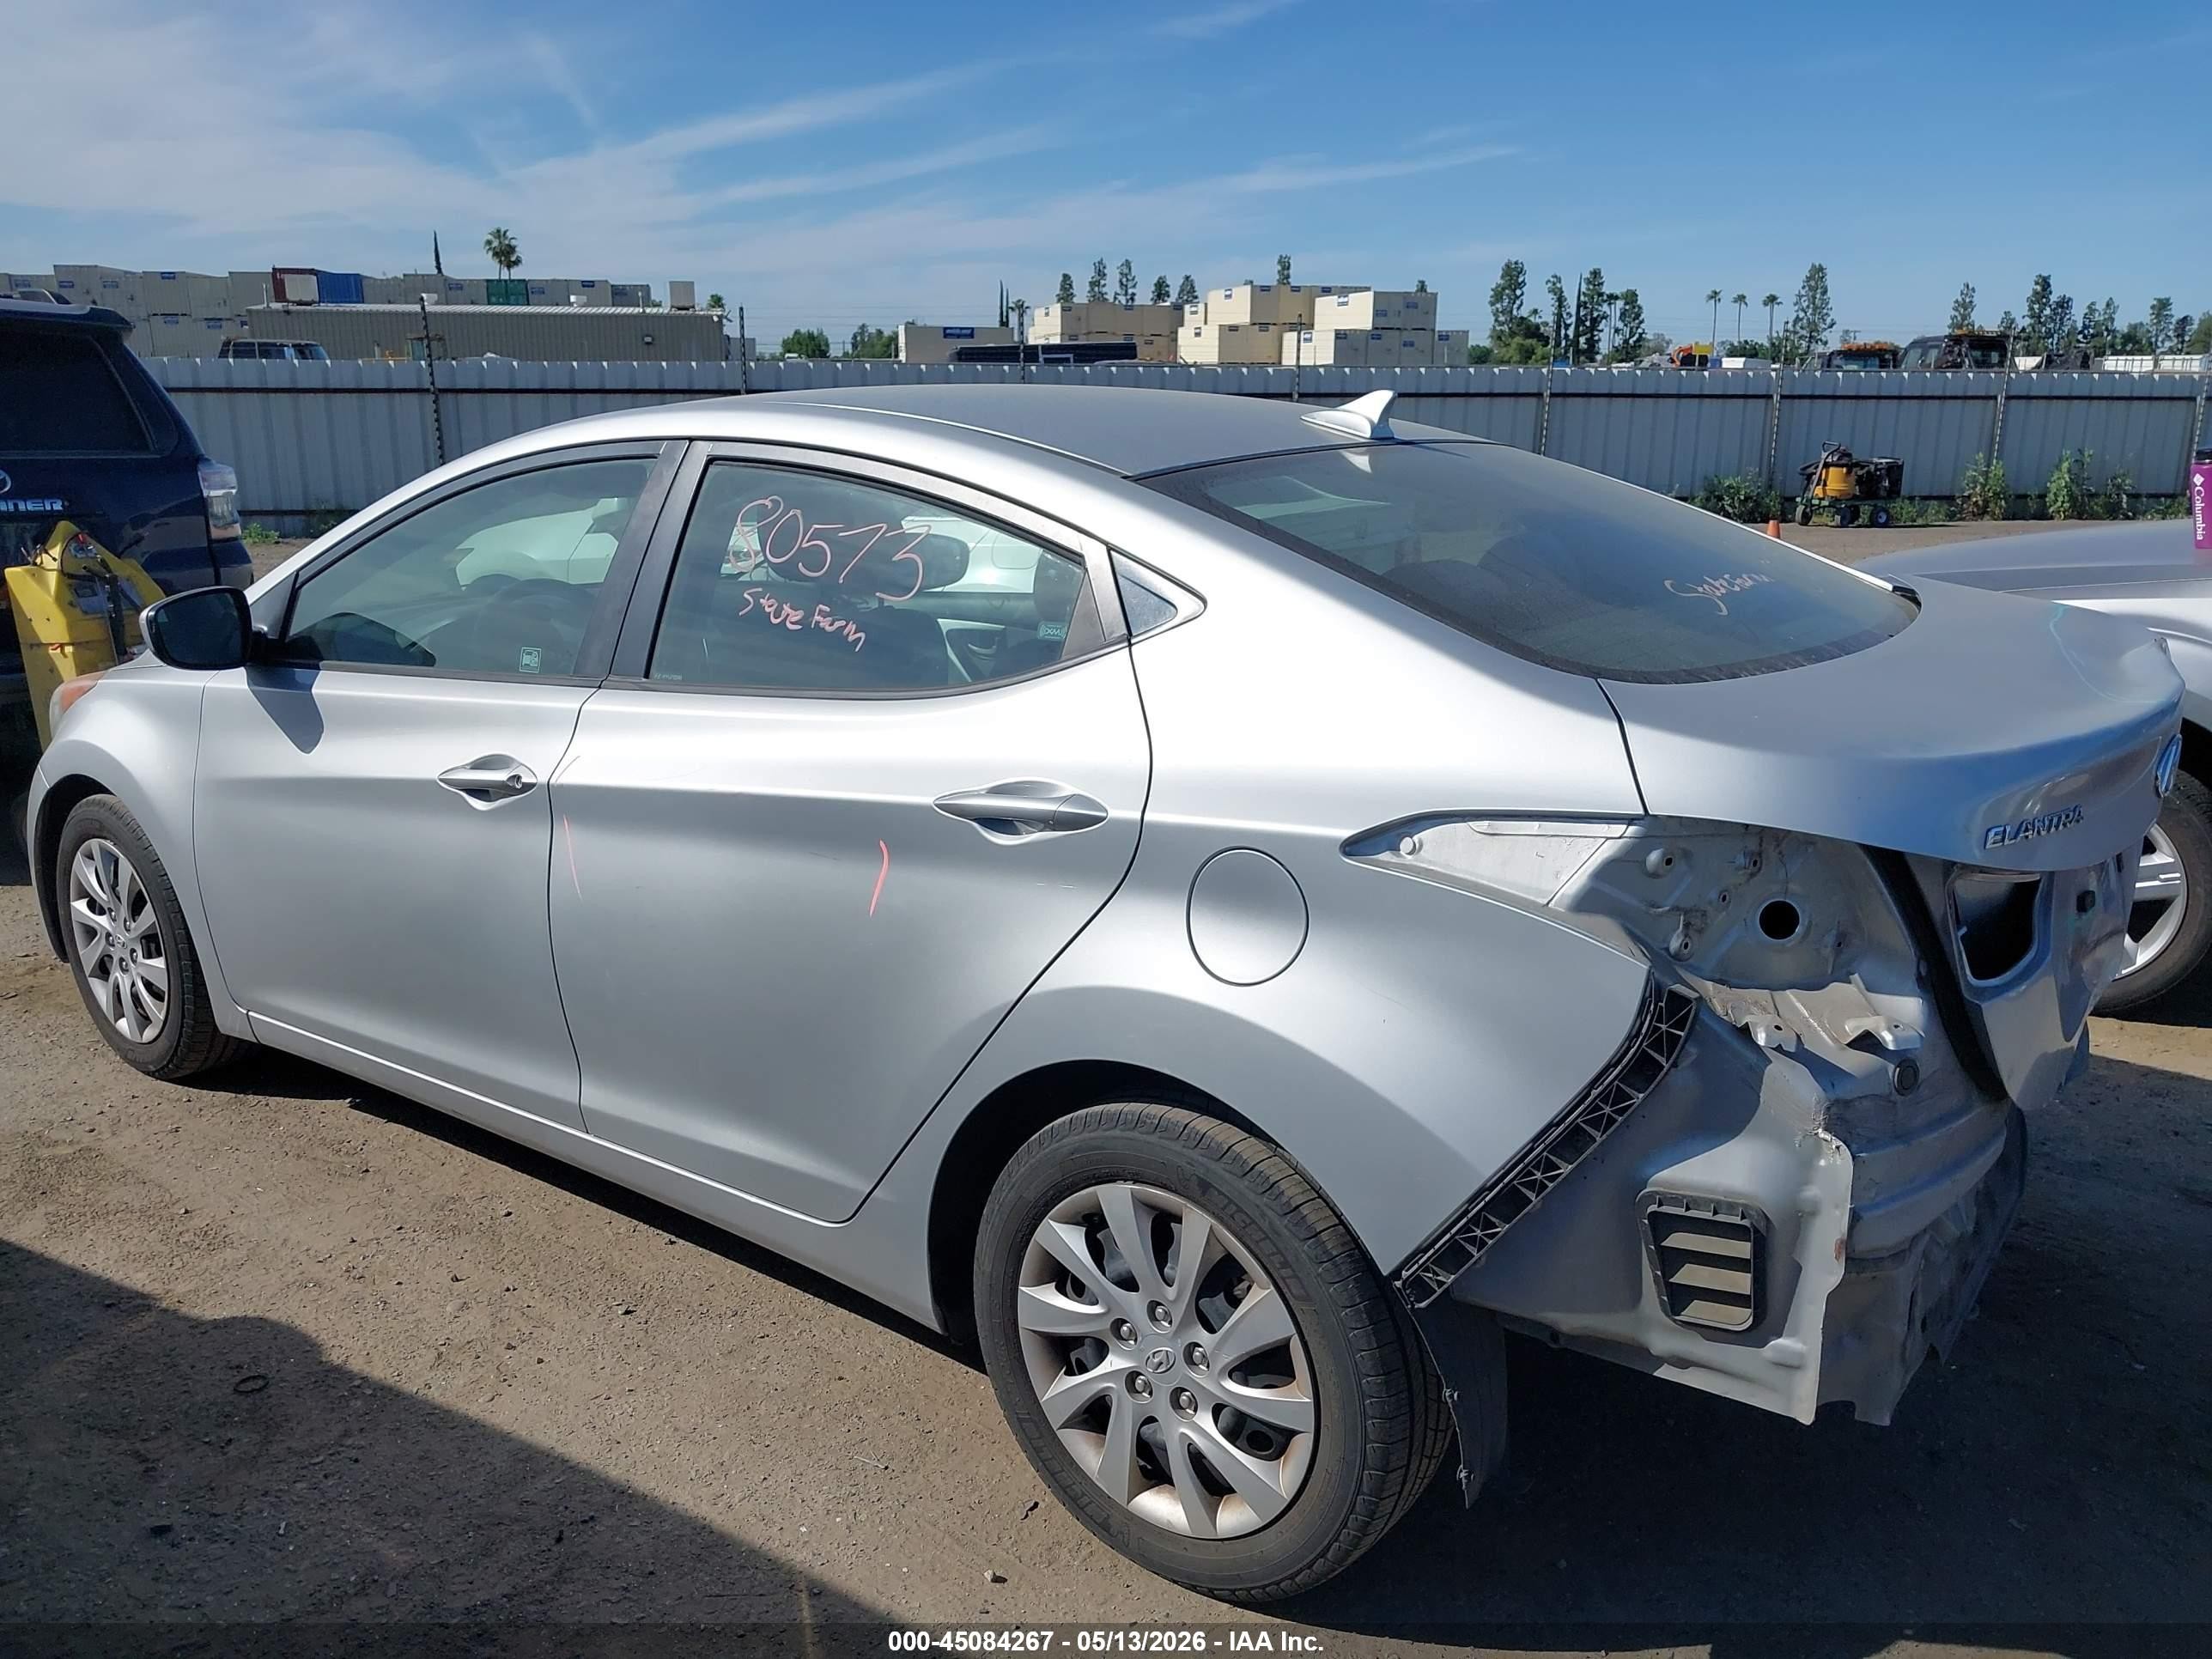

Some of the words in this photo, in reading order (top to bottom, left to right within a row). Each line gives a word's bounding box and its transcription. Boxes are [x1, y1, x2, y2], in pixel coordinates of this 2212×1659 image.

[2194, 486, 2206, 540] Columbia
[729, 495, 932, 601] 80573
[738, 587, 804, 630] State
[1984, 804, 2084, 849] ELANTRA
